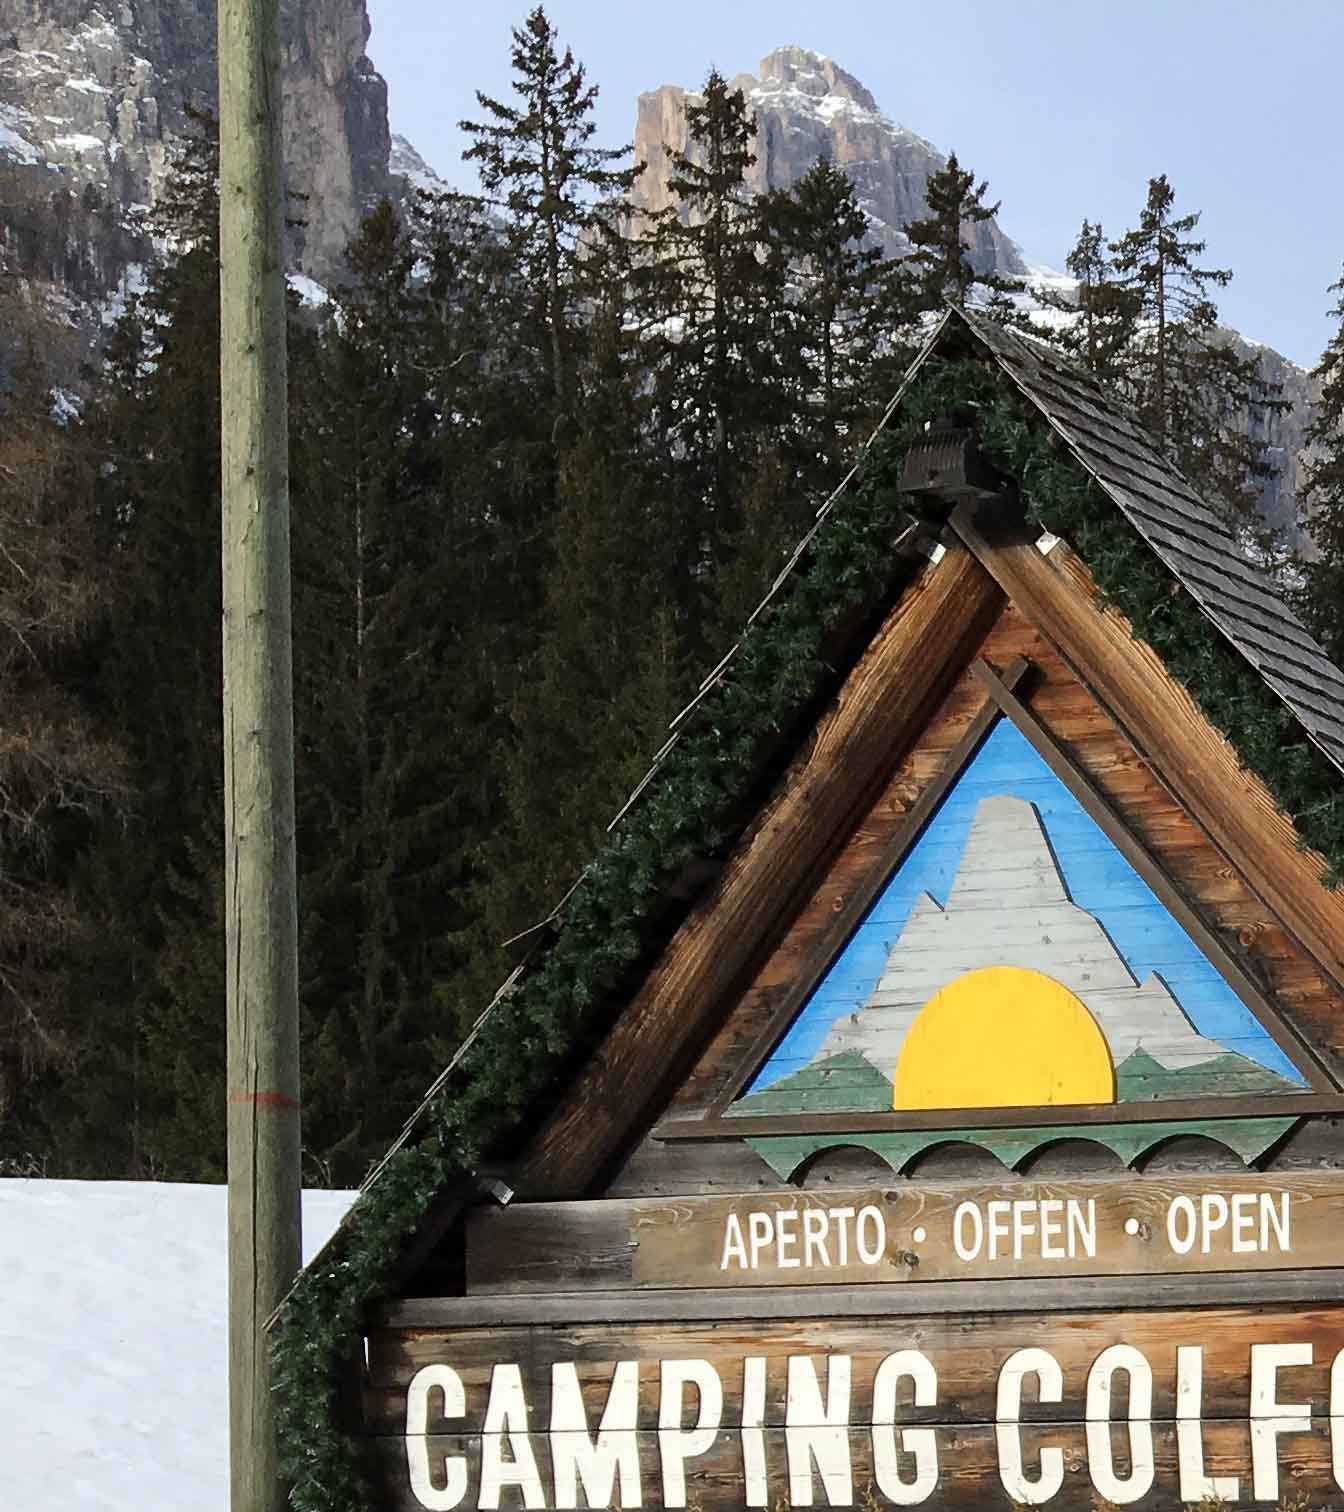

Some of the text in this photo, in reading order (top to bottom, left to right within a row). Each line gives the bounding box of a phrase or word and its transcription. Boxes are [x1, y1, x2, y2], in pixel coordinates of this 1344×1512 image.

[720, 1192, 1291, 1271] APERTO OFFEN OPEN
[405, 1347, 939, 1512] CAMPING
